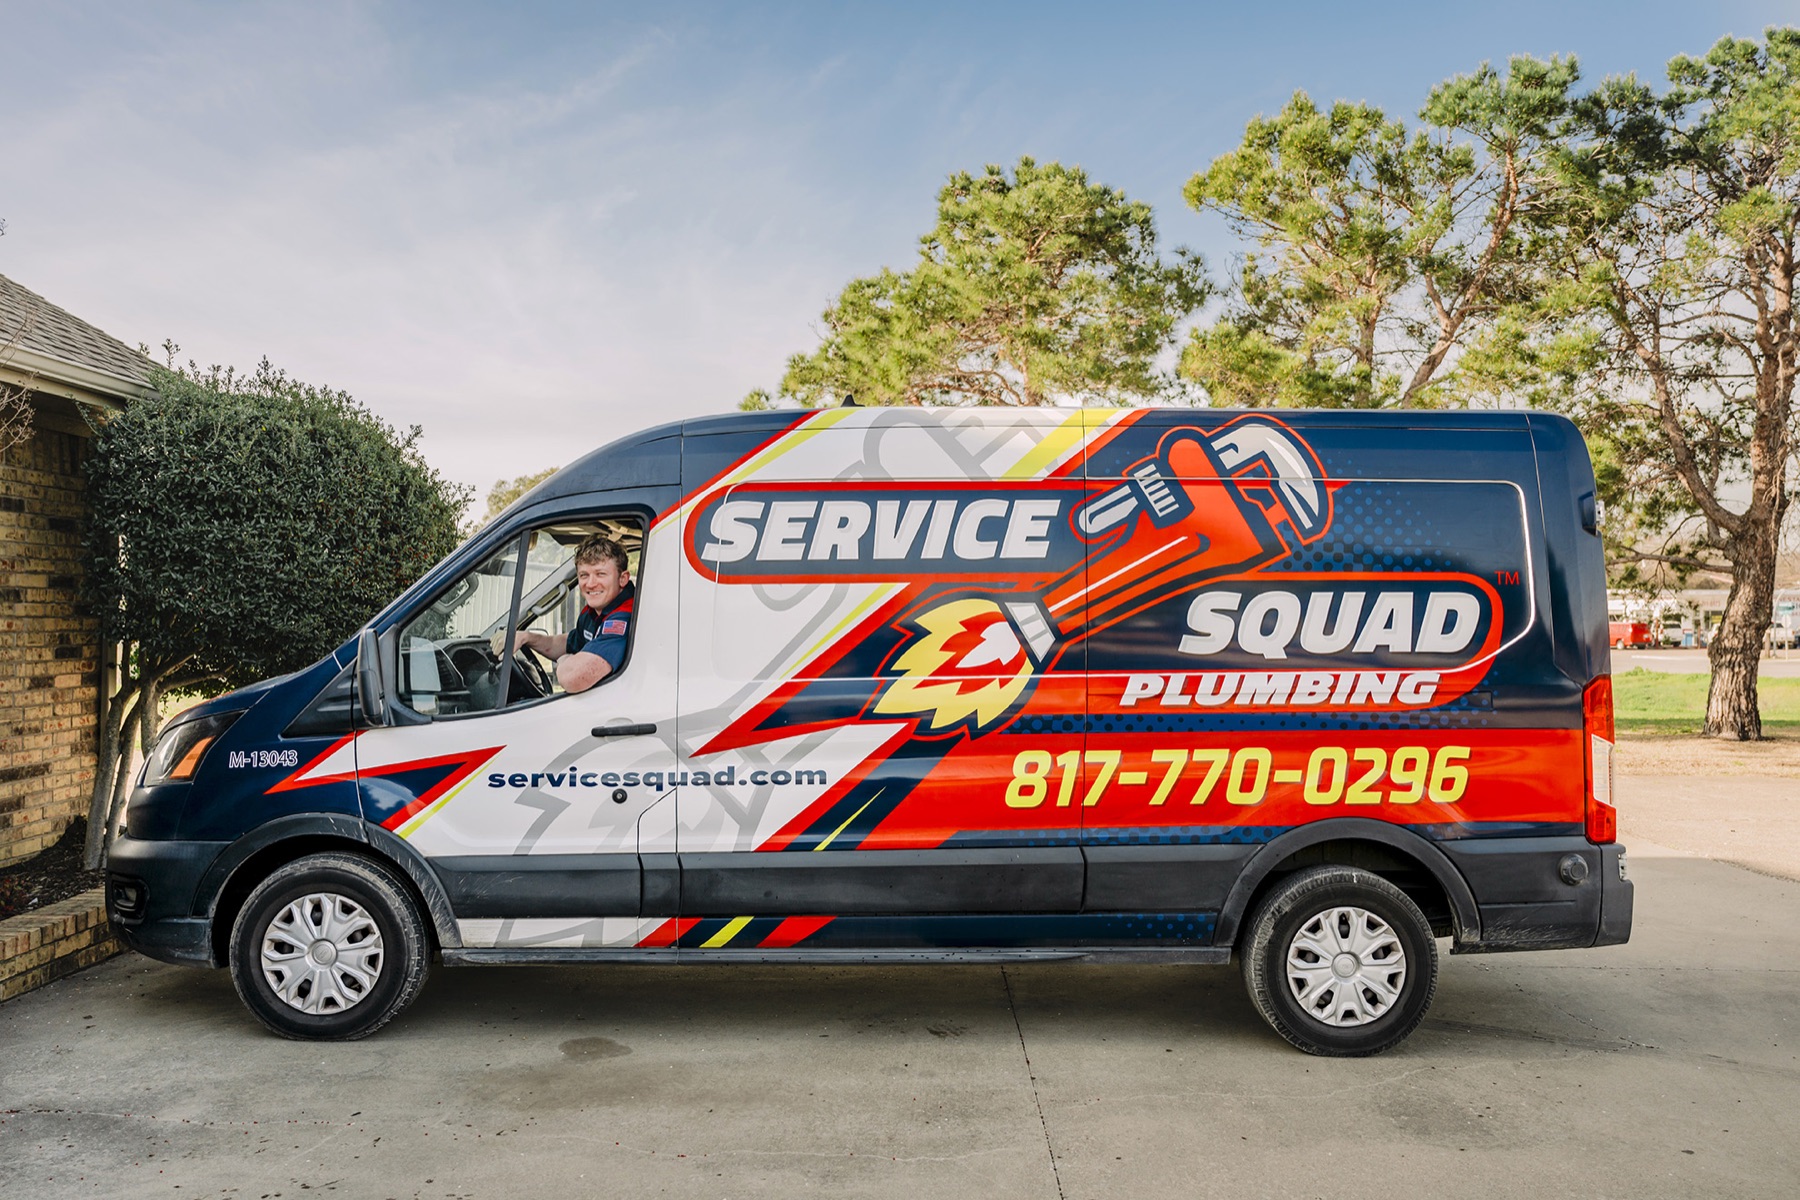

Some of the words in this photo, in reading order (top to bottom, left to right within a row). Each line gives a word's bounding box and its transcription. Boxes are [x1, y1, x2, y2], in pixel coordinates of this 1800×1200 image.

[700, 499, 1061, 563] SERVICE
[1494, 570, 1520, 585] TM
[1178, 591, 1480, 659] SQUAD
[1119, 673, 1440, 707] PLUMBING
[228, 750, 298, 768] M-13043
[487, 766, 827, 791] servicesquad.com
[1005, 745, 1471, 808] 817-770-0296
